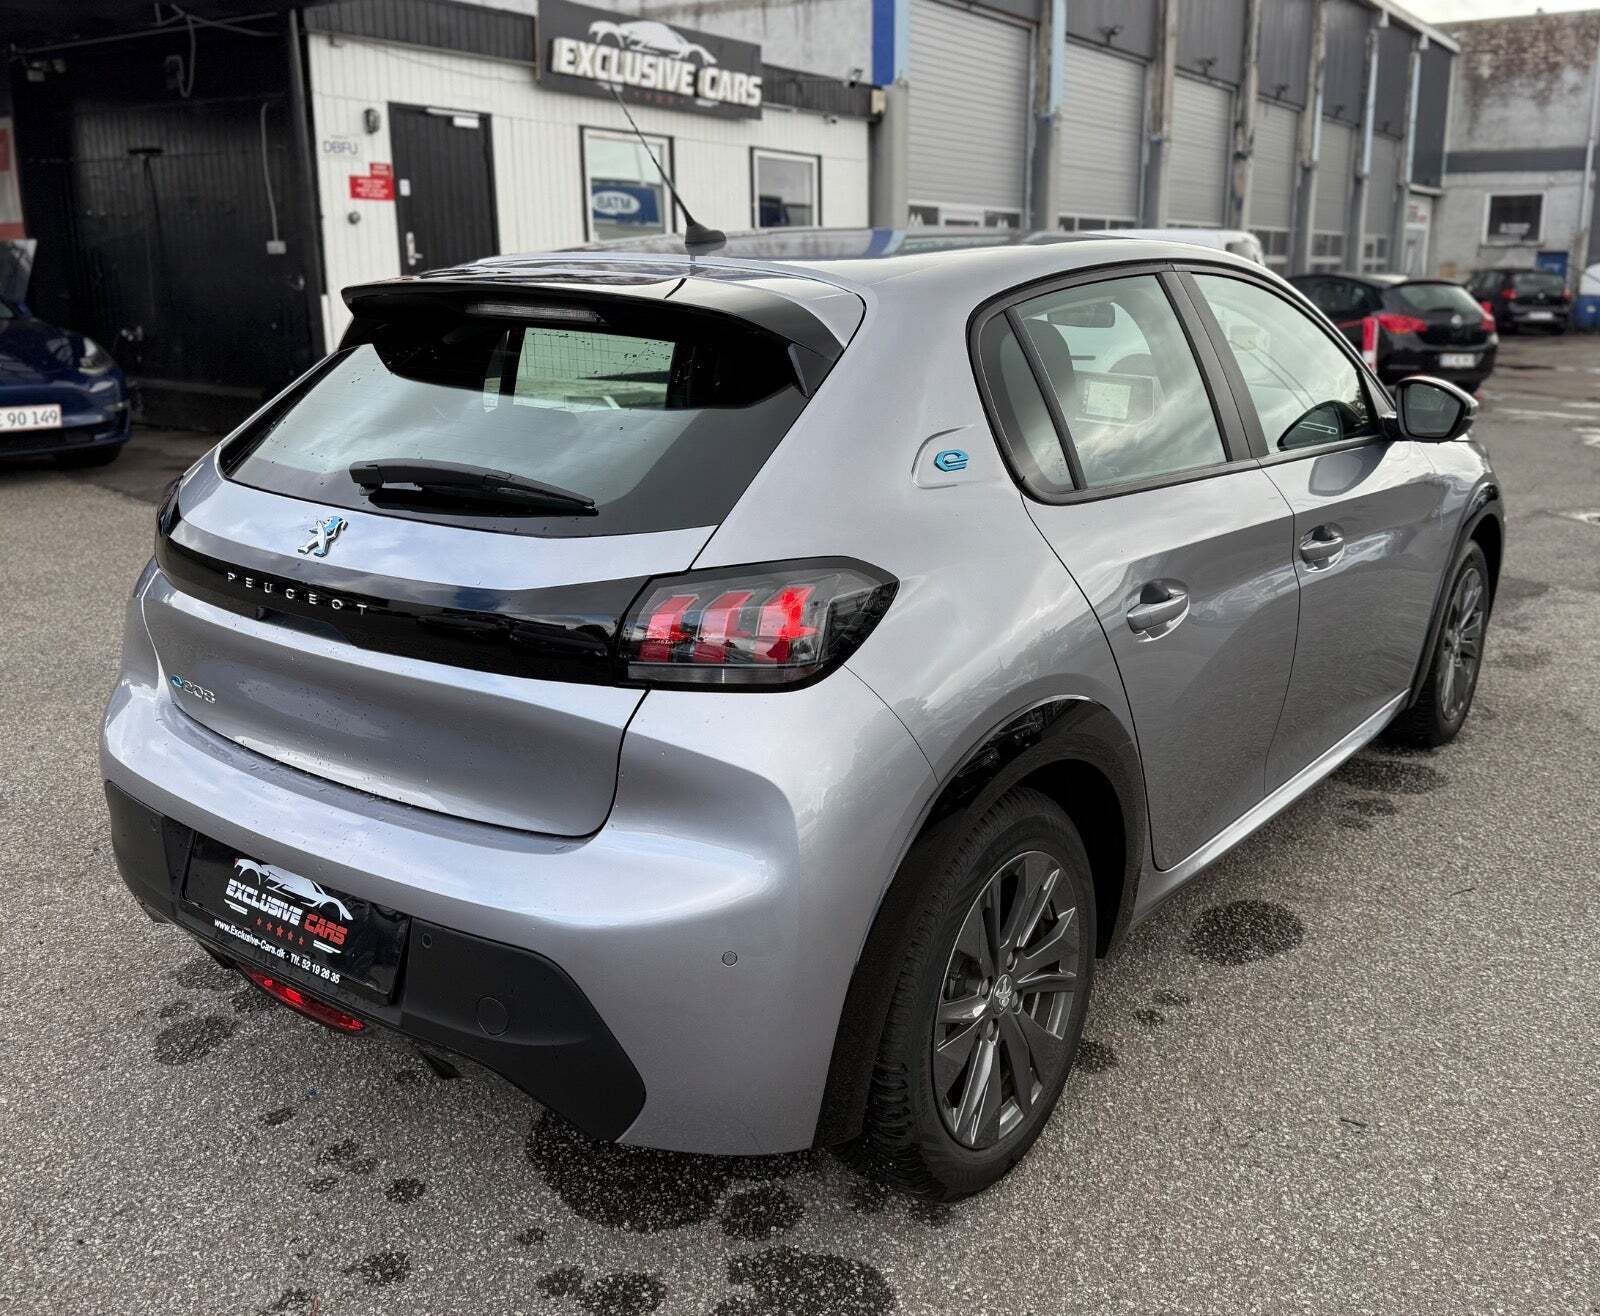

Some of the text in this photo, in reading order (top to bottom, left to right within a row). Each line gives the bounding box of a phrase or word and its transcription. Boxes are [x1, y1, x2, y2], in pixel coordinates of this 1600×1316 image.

[553, 37, 763, 107] EXCLUSIVE CARS
[7, 411, 27, 426] 90
[32, 409, 58, 425] 149
[227, 572, 368, 615] PEUGEOT
[225, 878, 348, 945] EXCLUSIVE CARS
[214, 919, 286, 960] www.Exclusive-Cars.dk
[301, 959, 311, 971] 52
[312, 964, 321, 975] 19
[330, 972, 341, 984] 35
